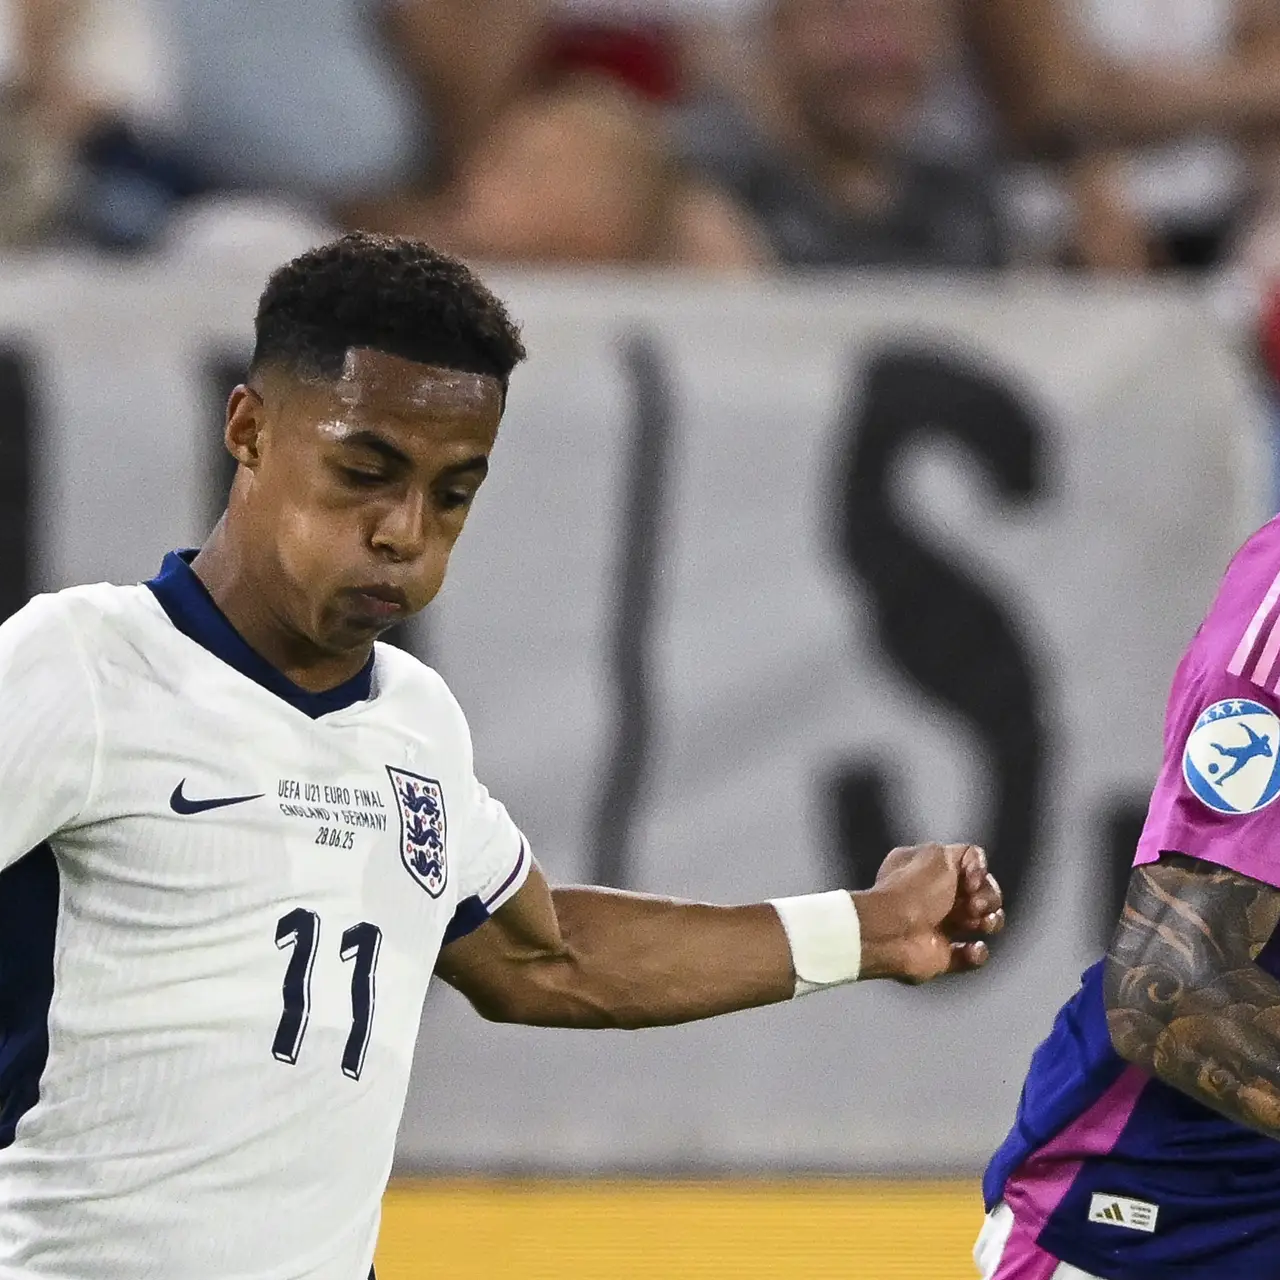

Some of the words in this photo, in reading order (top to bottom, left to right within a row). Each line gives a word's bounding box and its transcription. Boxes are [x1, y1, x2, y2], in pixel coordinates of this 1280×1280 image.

[278, 779, 300, 800] UEFA
[304, 783, 321, 803] U21
[324, 785, 351, 806] EURO
[354, 788, 385, 808] FINAL
[279, 803, 331, 821] ENGLAND
[341, 809, 387, 832] GERMANY
[315, 826, 355, 850] 28.06.25
[271, 907, 383, 1082] 11
